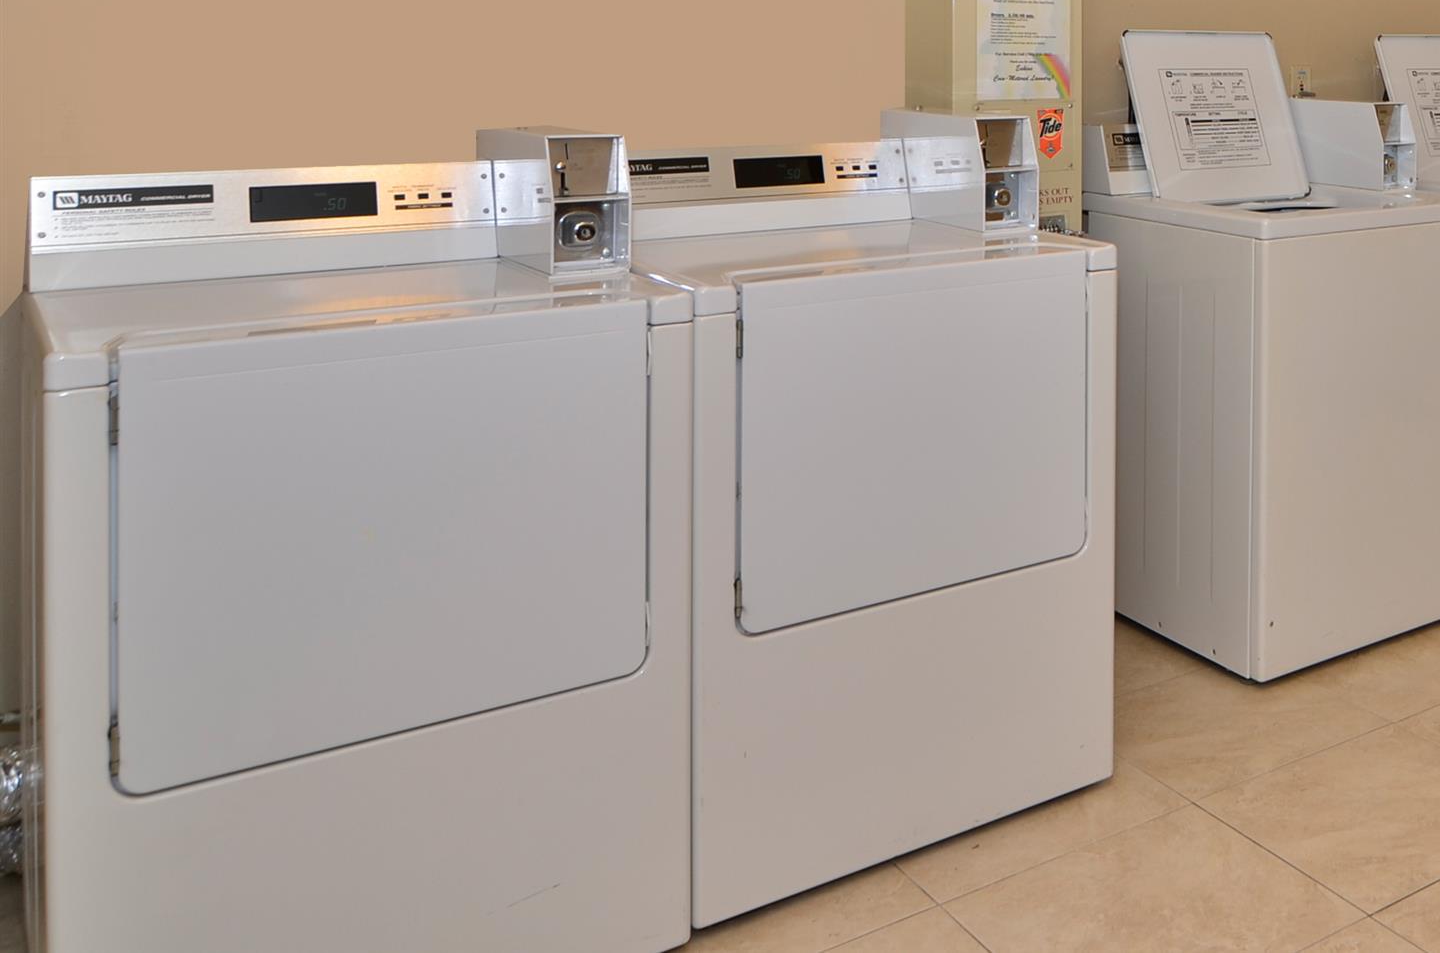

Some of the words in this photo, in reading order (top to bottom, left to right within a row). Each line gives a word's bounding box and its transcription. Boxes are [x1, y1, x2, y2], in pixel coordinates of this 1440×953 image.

[1039, 118, 1062, 138] Tide
[1051, 188, 1068, 196] OUT
[80, 193, 133, 204] MAYTAG
[1046, 196, 1073, 205] EMPTY
